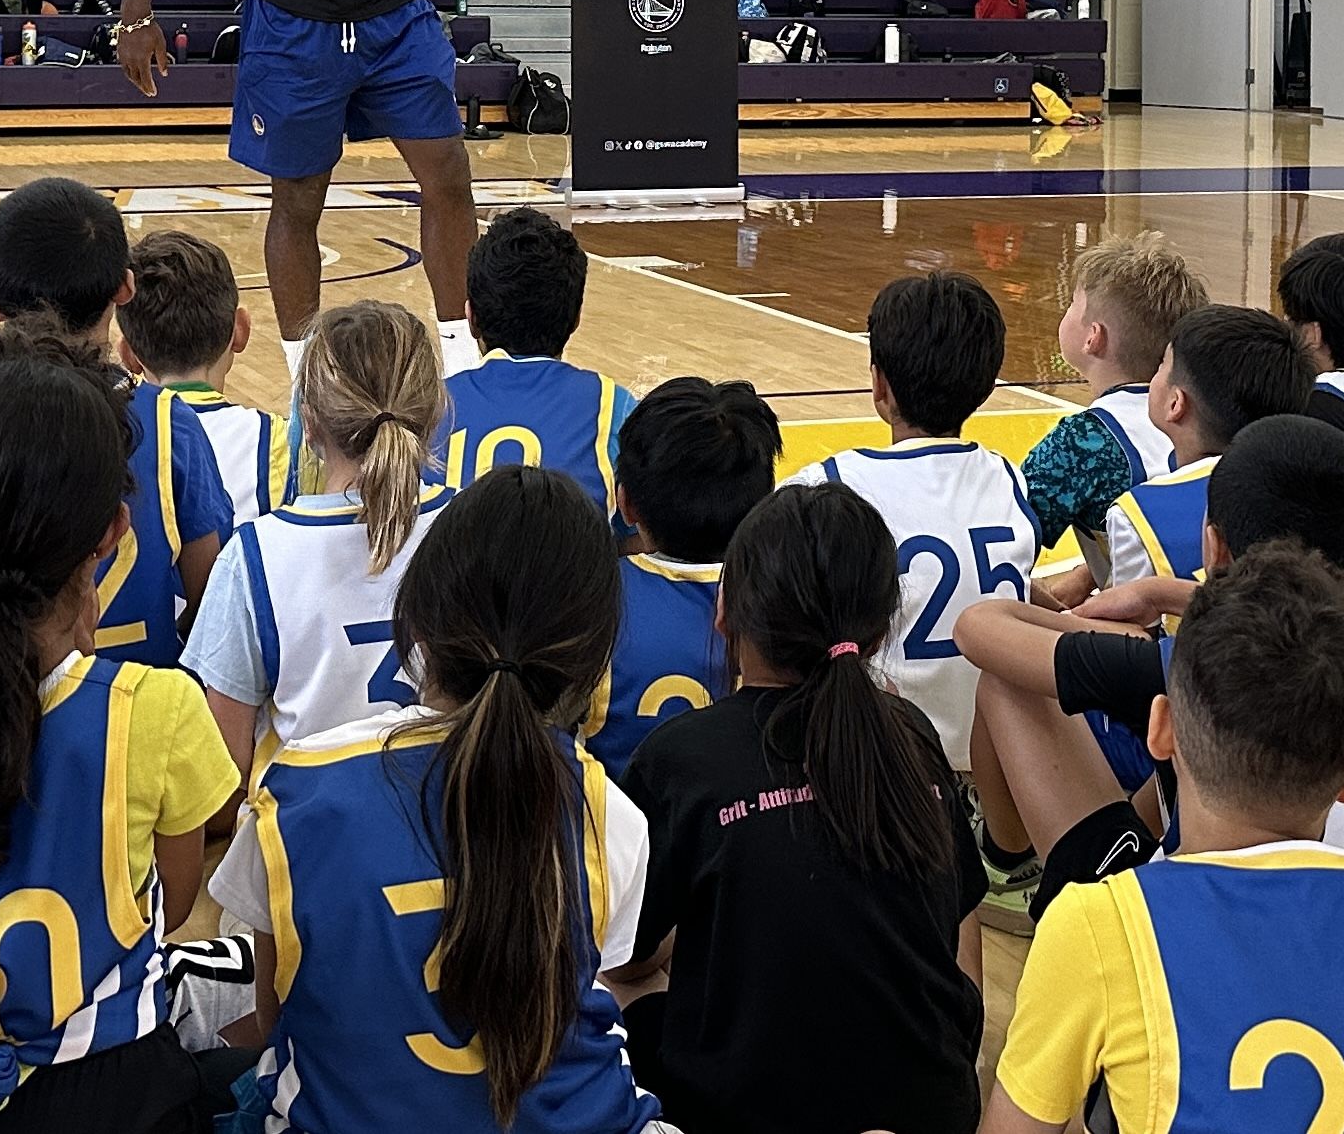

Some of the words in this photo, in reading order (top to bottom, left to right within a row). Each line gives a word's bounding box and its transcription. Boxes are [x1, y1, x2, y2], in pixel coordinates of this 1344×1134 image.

[898, 526, 1026, 660] 25
[718, 799, 749, 826] Grit
[758, 783, 815, 812] Attitud
